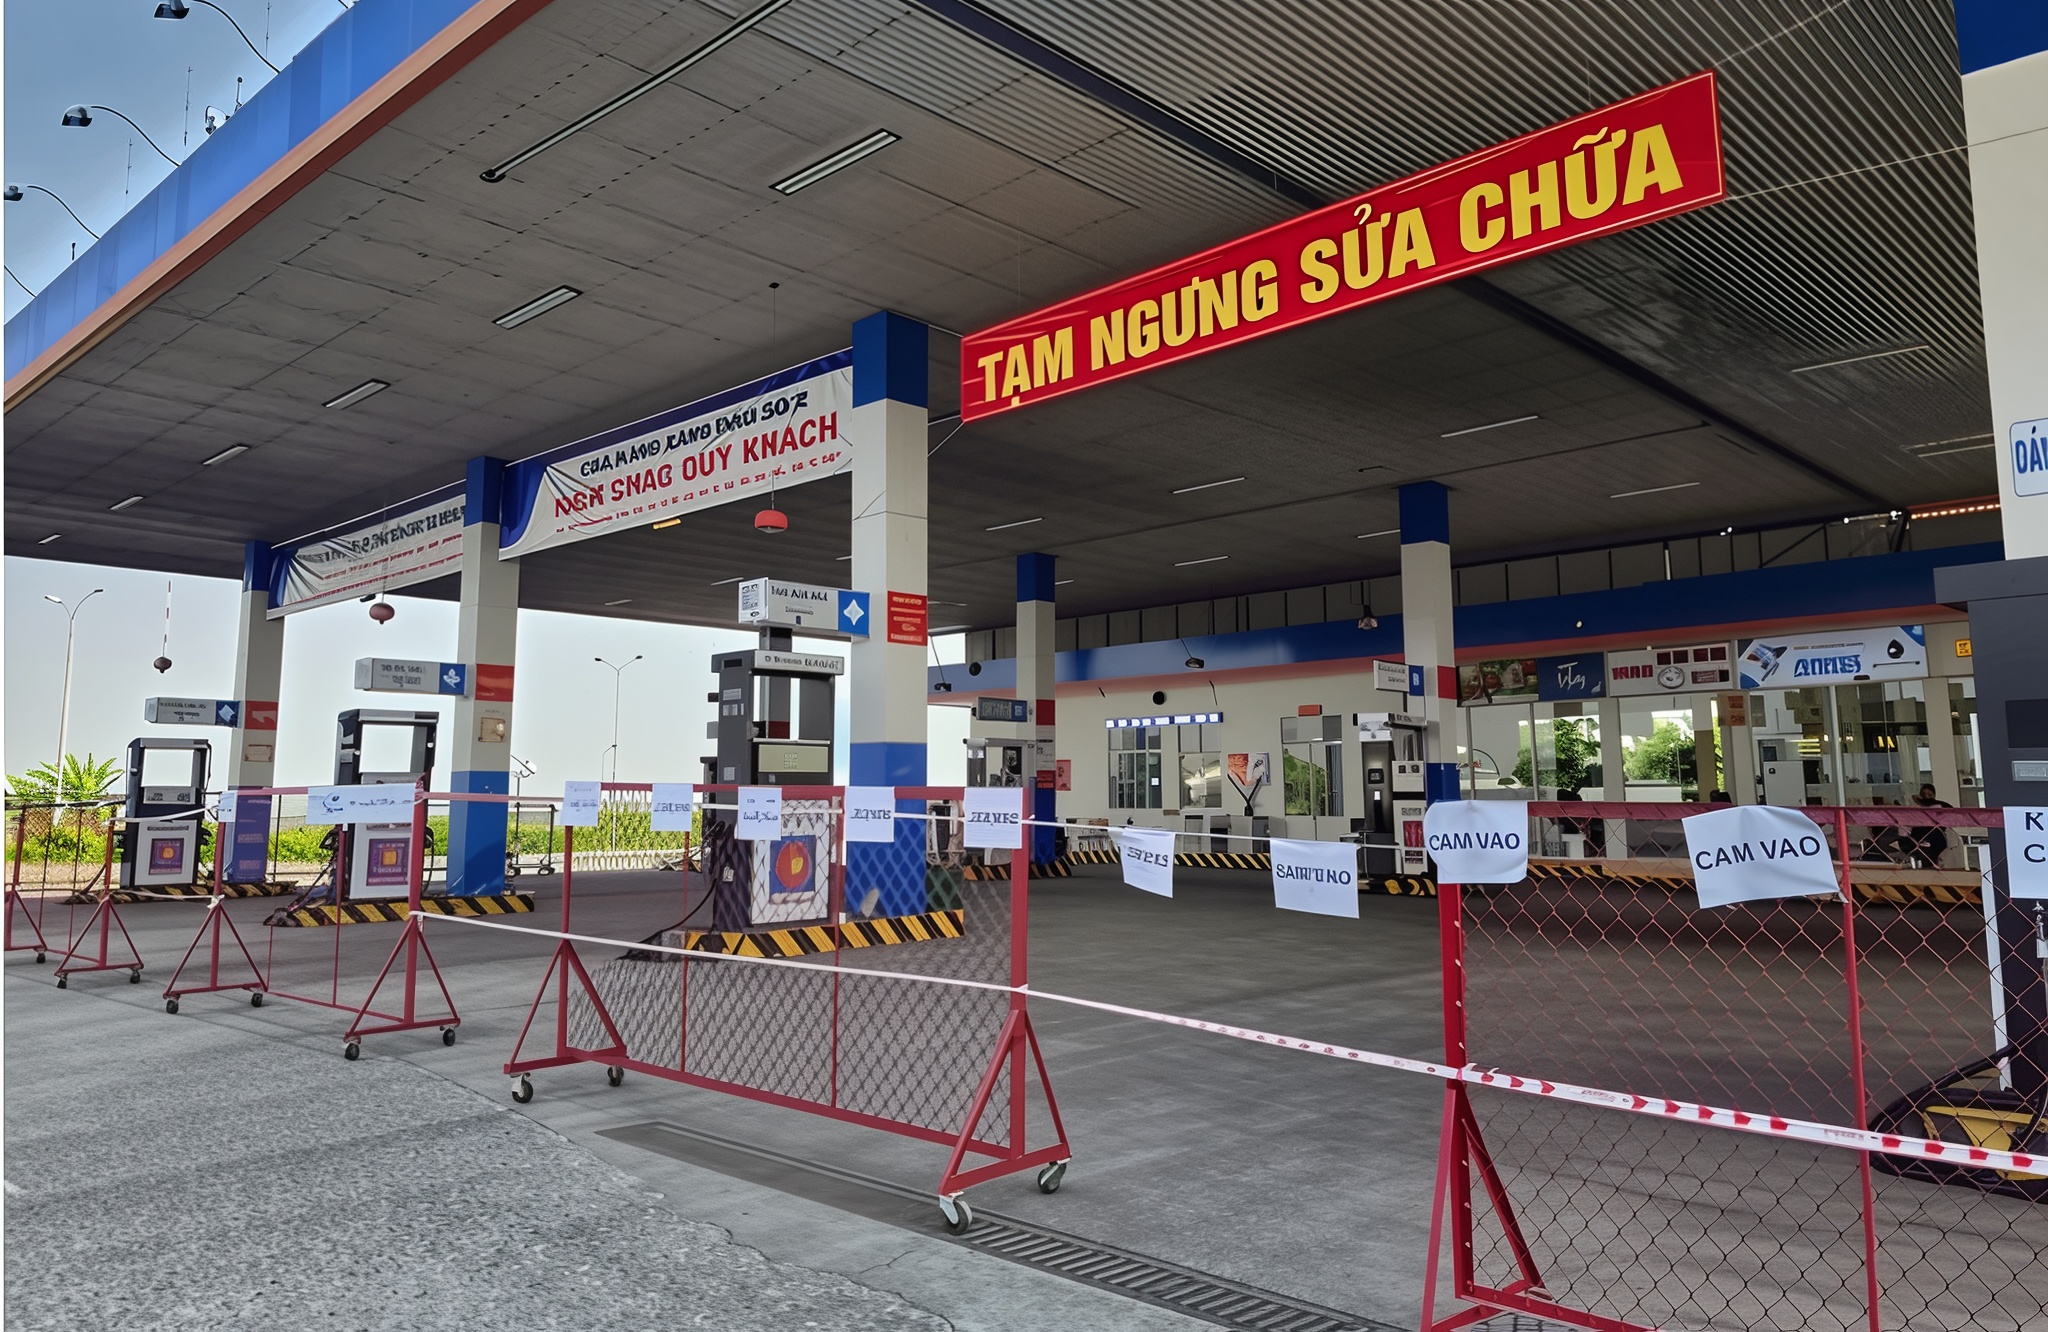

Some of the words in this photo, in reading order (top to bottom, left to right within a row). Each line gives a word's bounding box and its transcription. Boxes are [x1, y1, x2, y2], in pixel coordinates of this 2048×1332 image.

[977, 326, 1074, 407] TẠM
[1090, 258, 1279, 372] NGƯNG
[1299, 203, 1437, 305] SỬA
[1459, 124, 1685, 253] CHỮA
[1429, 832, 1473, 851] CAM
[1475, 832, 1520, 850] VAO
[1695, 842, 1755, 870] CAM
[1759, 836, 1821, 860] VAO
